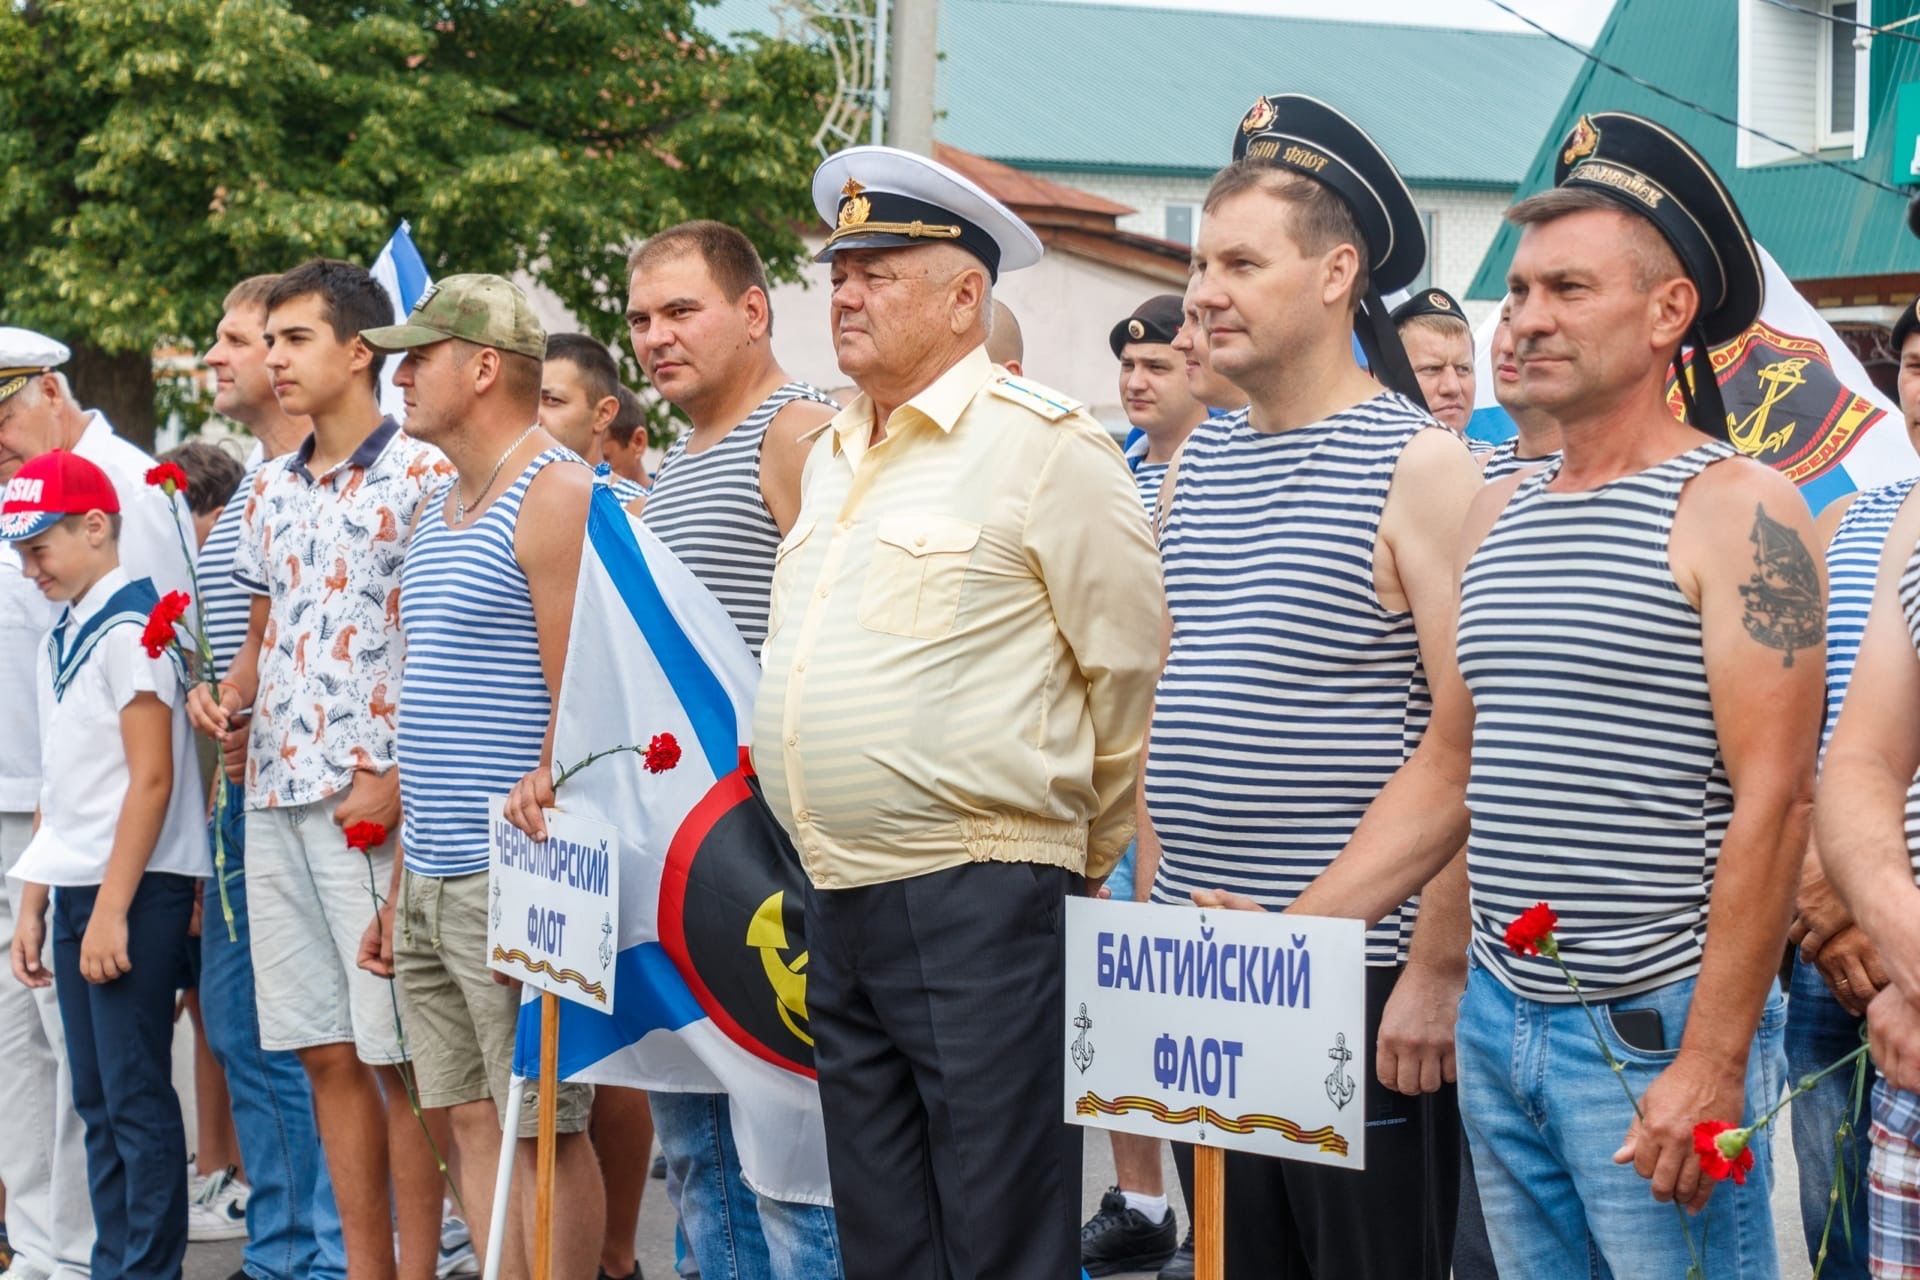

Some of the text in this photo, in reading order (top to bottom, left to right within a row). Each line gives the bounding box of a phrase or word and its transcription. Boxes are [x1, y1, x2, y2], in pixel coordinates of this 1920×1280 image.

[496, 822, 609, 897] ЧЕРНОМОРСКИЙ
[527, 904, 566, 957] ФЛОТ
[1097, 926, 1311, 1009] БАЛТИЙСКИЙ
[1153, 1033, 1243, 1099] ФЛОТ
